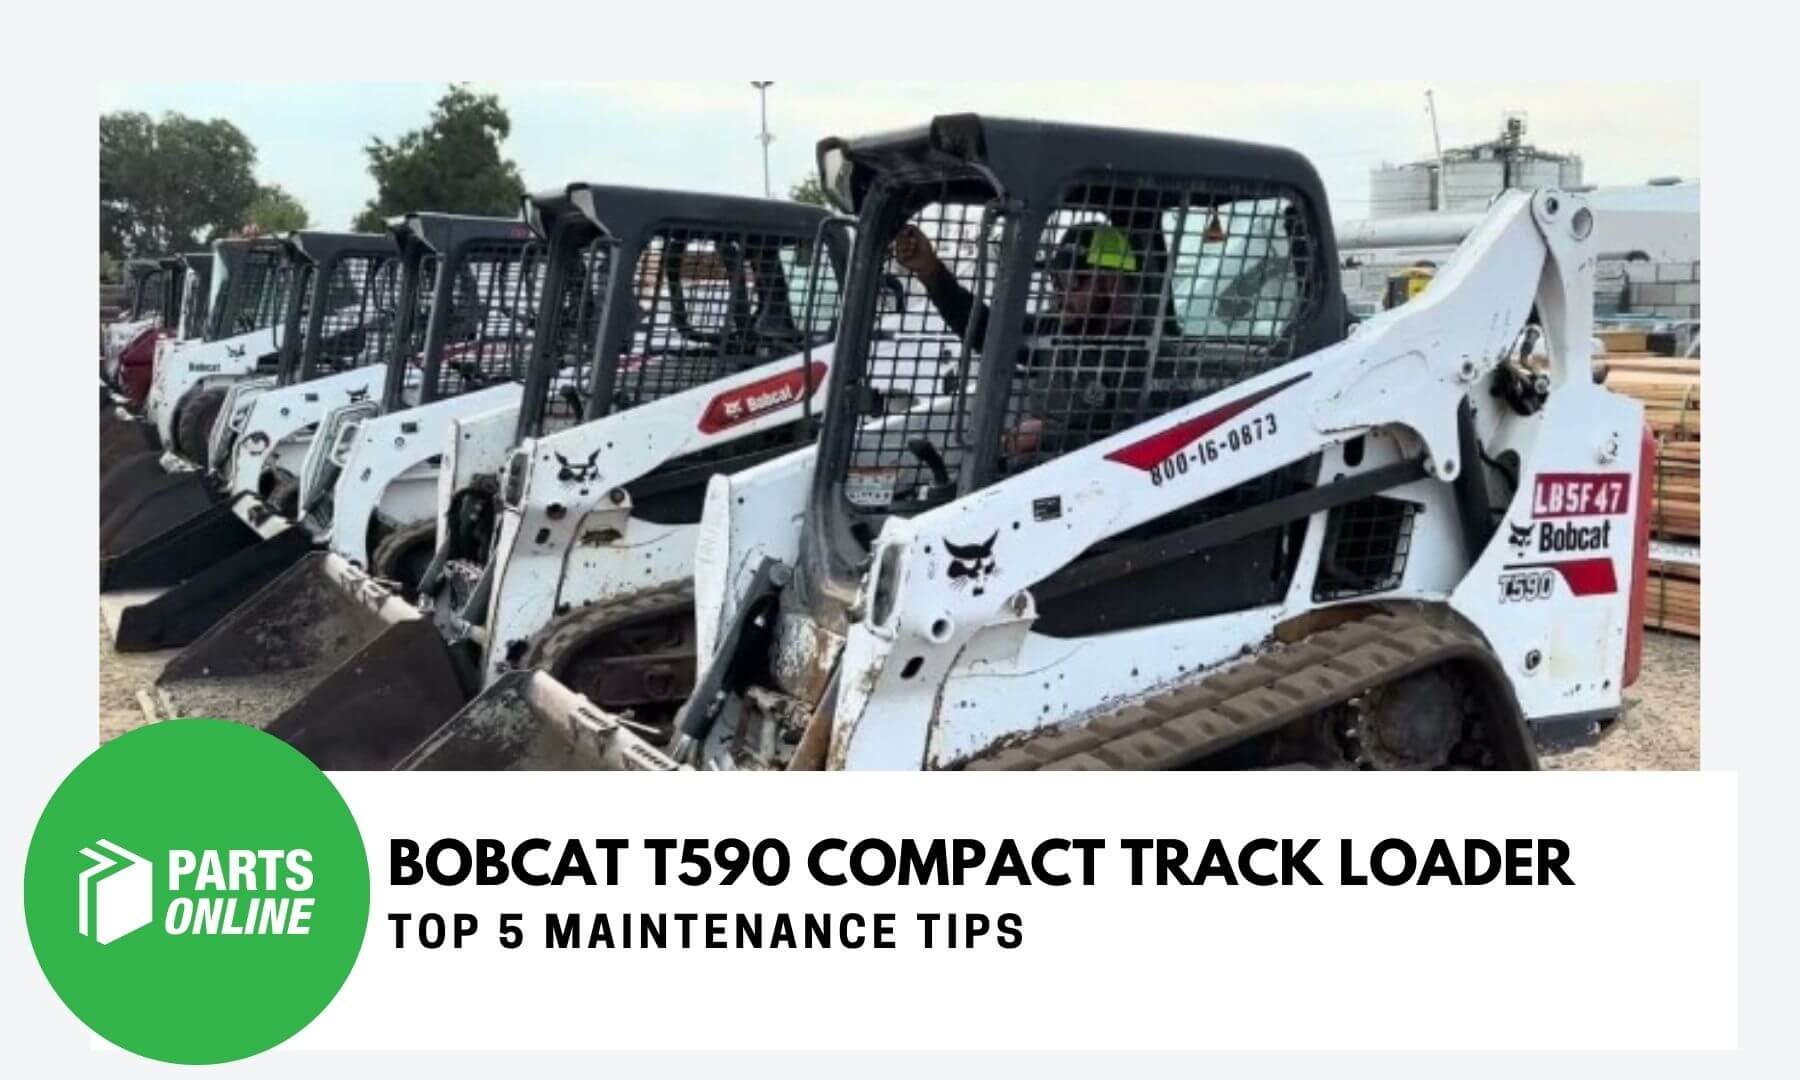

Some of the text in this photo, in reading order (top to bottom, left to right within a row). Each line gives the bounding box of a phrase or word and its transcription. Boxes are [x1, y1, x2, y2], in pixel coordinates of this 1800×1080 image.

[747, 383, 793, 412] Bobcat
[1150, 412, 1278, 487] 800-16-0873
[1534, 481, 1623, 515] LB5F47
[1538, 519, 1611, 553] Bobcat
[1499, 570, 1555, 604] T590
